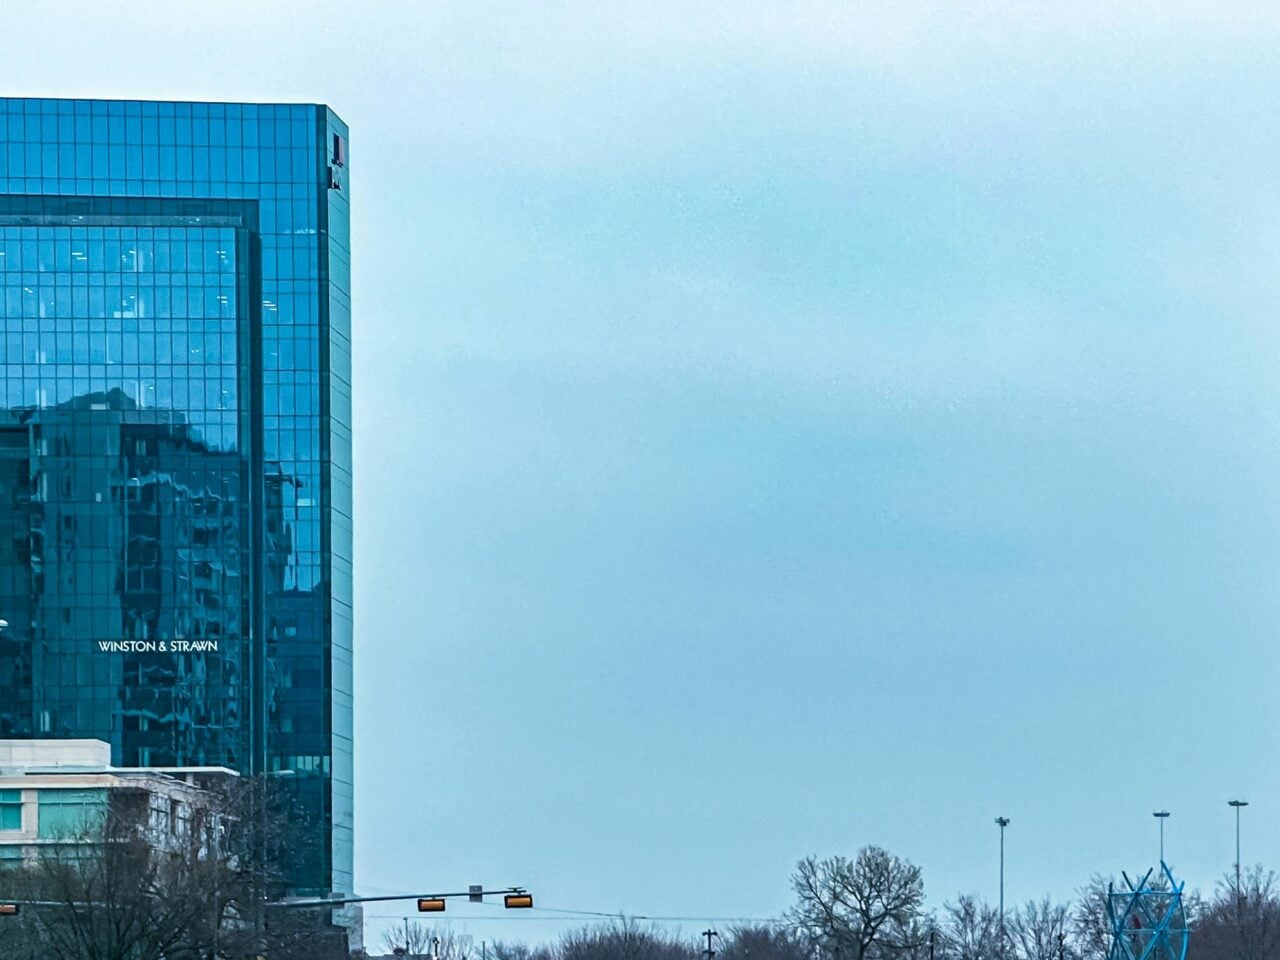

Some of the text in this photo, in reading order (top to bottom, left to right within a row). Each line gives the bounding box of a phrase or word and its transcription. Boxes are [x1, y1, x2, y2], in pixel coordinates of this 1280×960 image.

[98, 640, 218, 652] WINSTON & STRAWN
